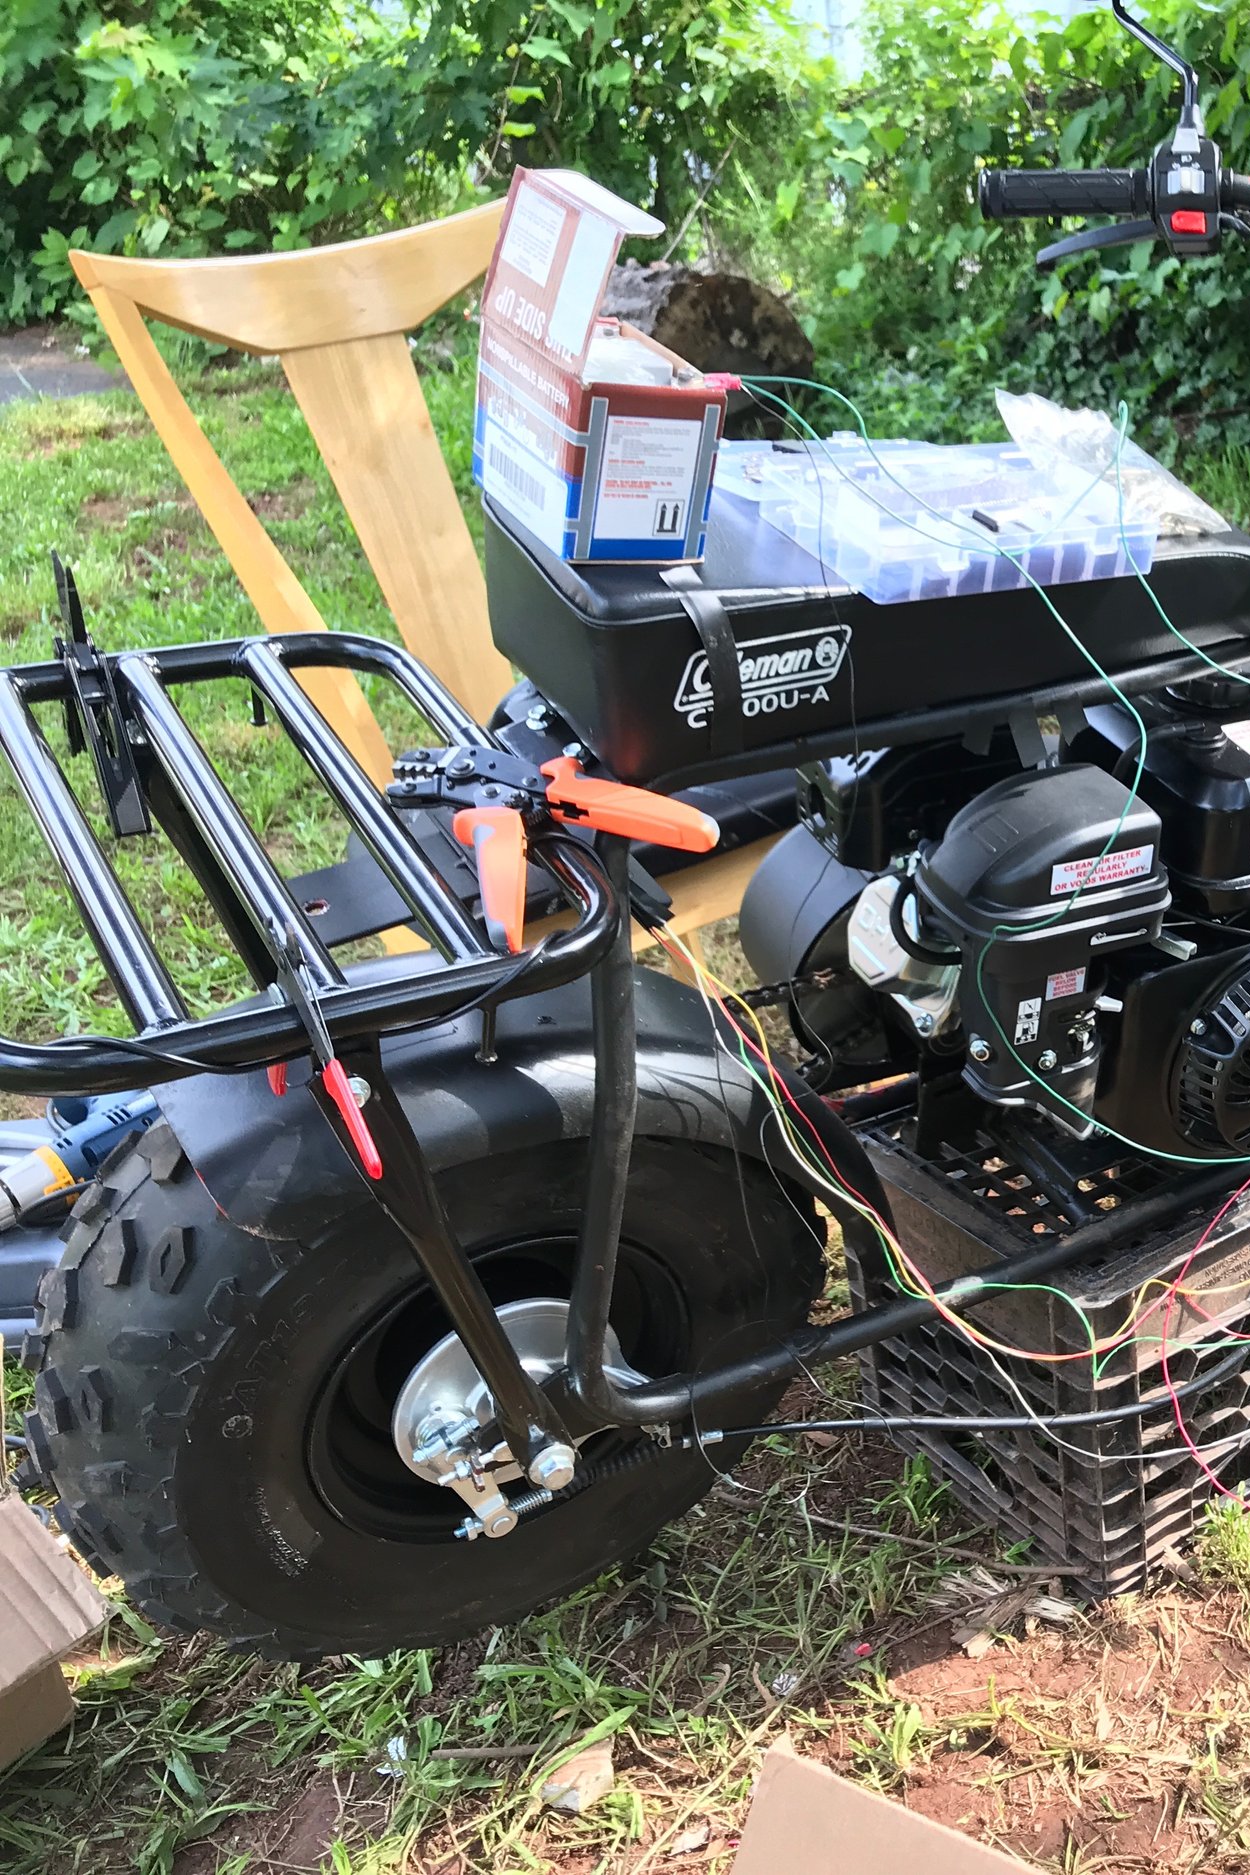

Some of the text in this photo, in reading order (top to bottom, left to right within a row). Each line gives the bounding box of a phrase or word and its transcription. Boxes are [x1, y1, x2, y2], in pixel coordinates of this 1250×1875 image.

[494, 286, 546, 340] SIDE UP
[537, 375, 570, 410] BATTERY
[693, 647, 813, 692] Ceman
[1064, 861, 1093, 872] CLEAN
[1113, 850, 1141, 861] FILTER
[1077, 862, 1127, 878] REULARLY
